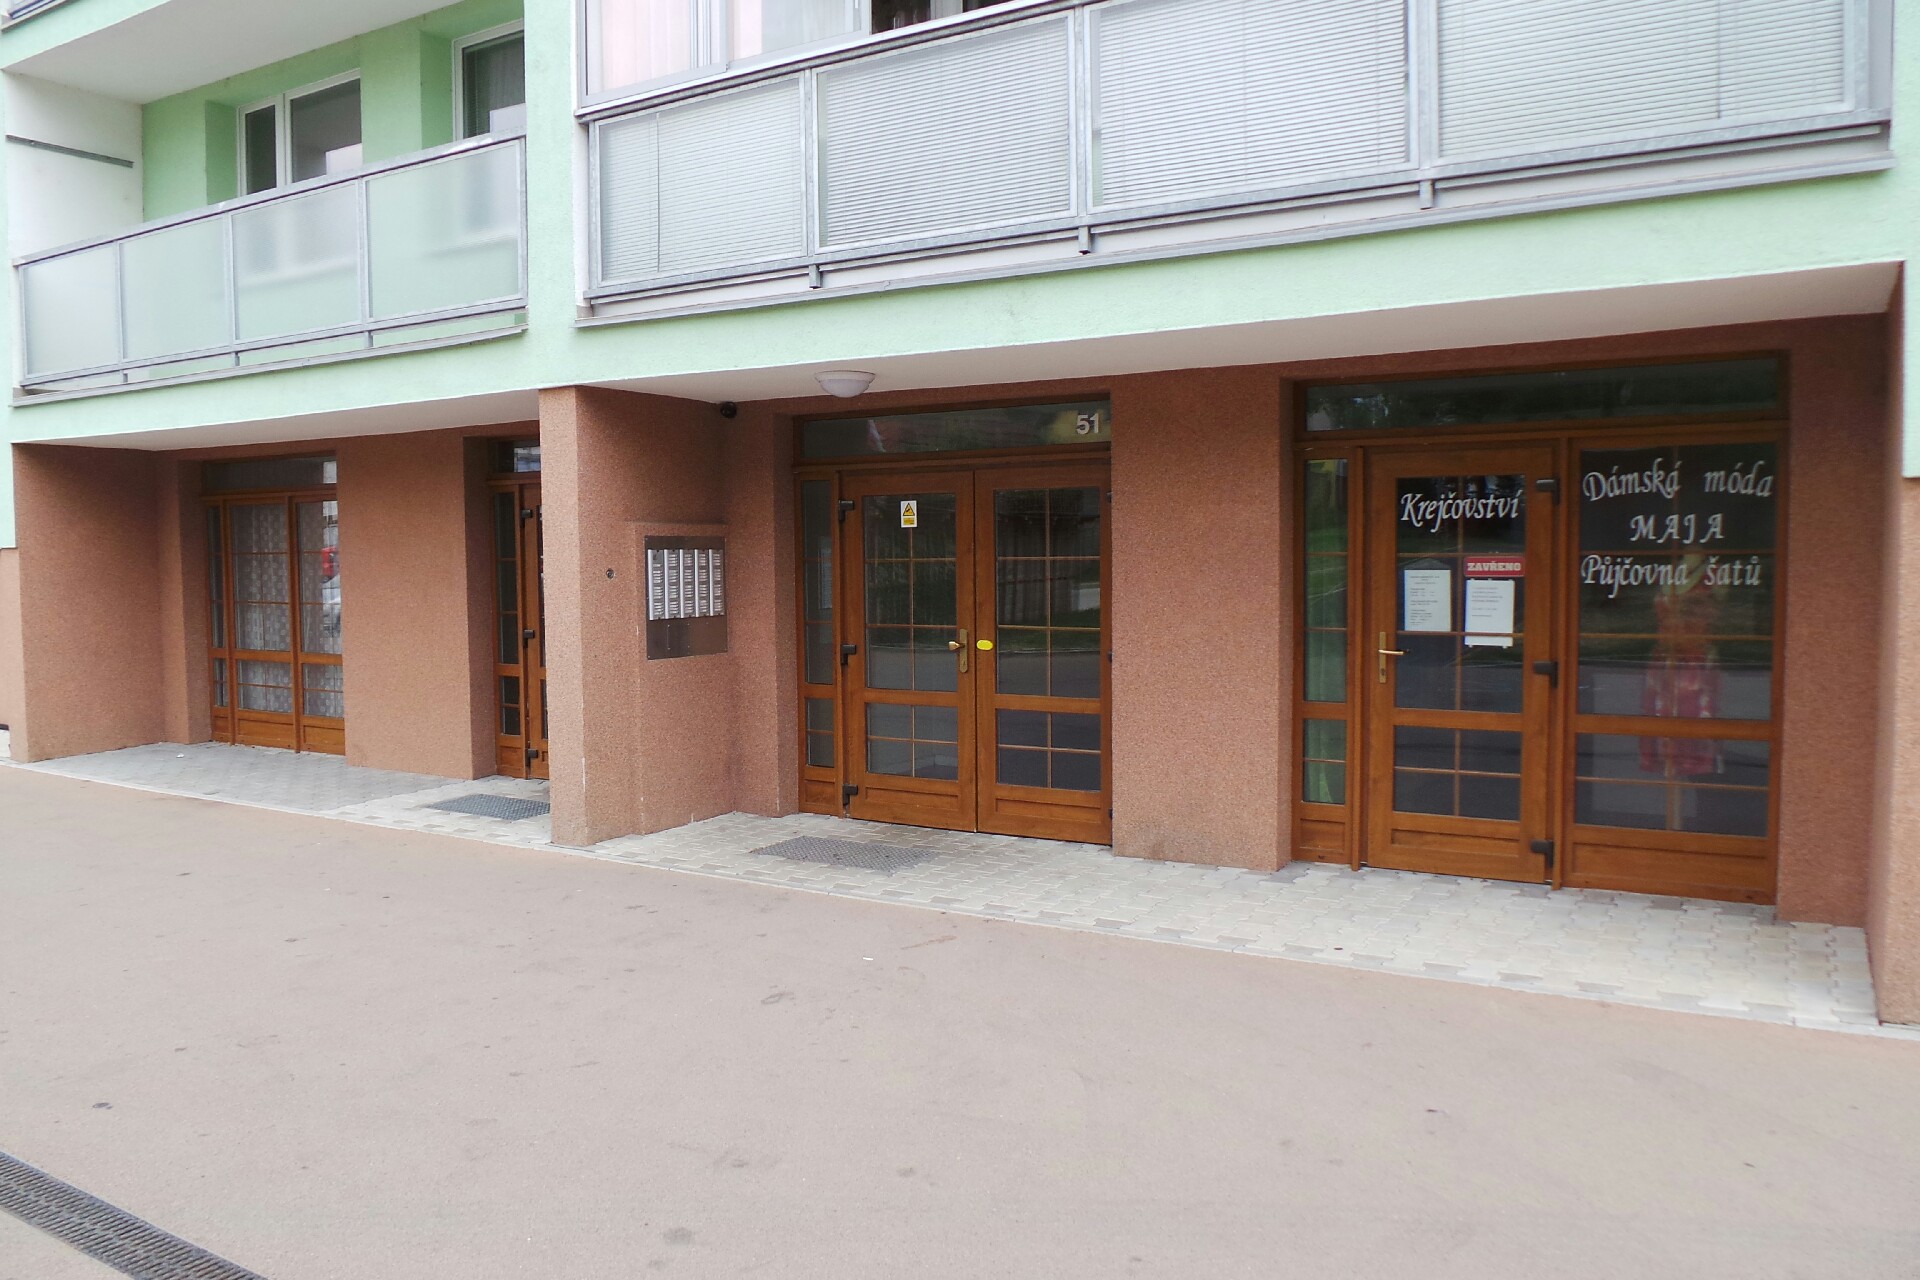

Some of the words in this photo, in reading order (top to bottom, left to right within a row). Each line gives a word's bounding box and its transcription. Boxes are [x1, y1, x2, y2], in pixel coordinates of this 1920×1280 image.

[1076, 413, 1099, 435] 51
[1582, 457, 1683, 501] Dámská
[1704, 460, 1773, 497] móda
[1400, 489, 1524, 533] Krejčovství
[1467, 561, 1521, 571] ZAVŘENO
[1581, 554, 1688, 598] Půjčovna
[1704, 555, 1762, 586] šatů
